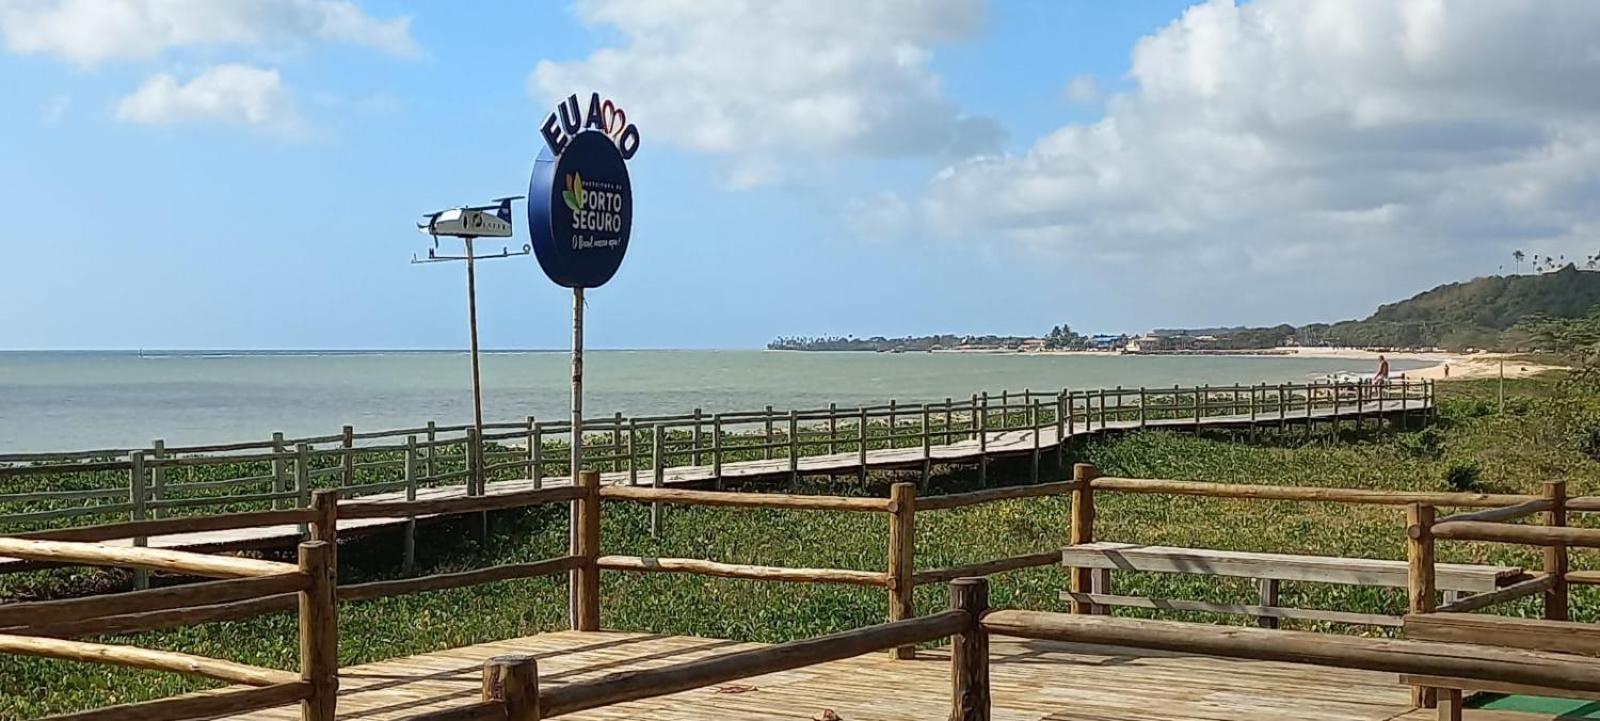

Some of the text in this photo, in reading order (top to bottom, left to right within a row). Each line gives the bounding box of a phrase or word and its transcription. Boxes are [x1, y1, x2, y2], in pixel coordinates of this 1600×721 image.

[540, 93, 581, 156] EU
[580, 189, 622, 212] PORTO
[572, 209, 621, 233] SEGURO
